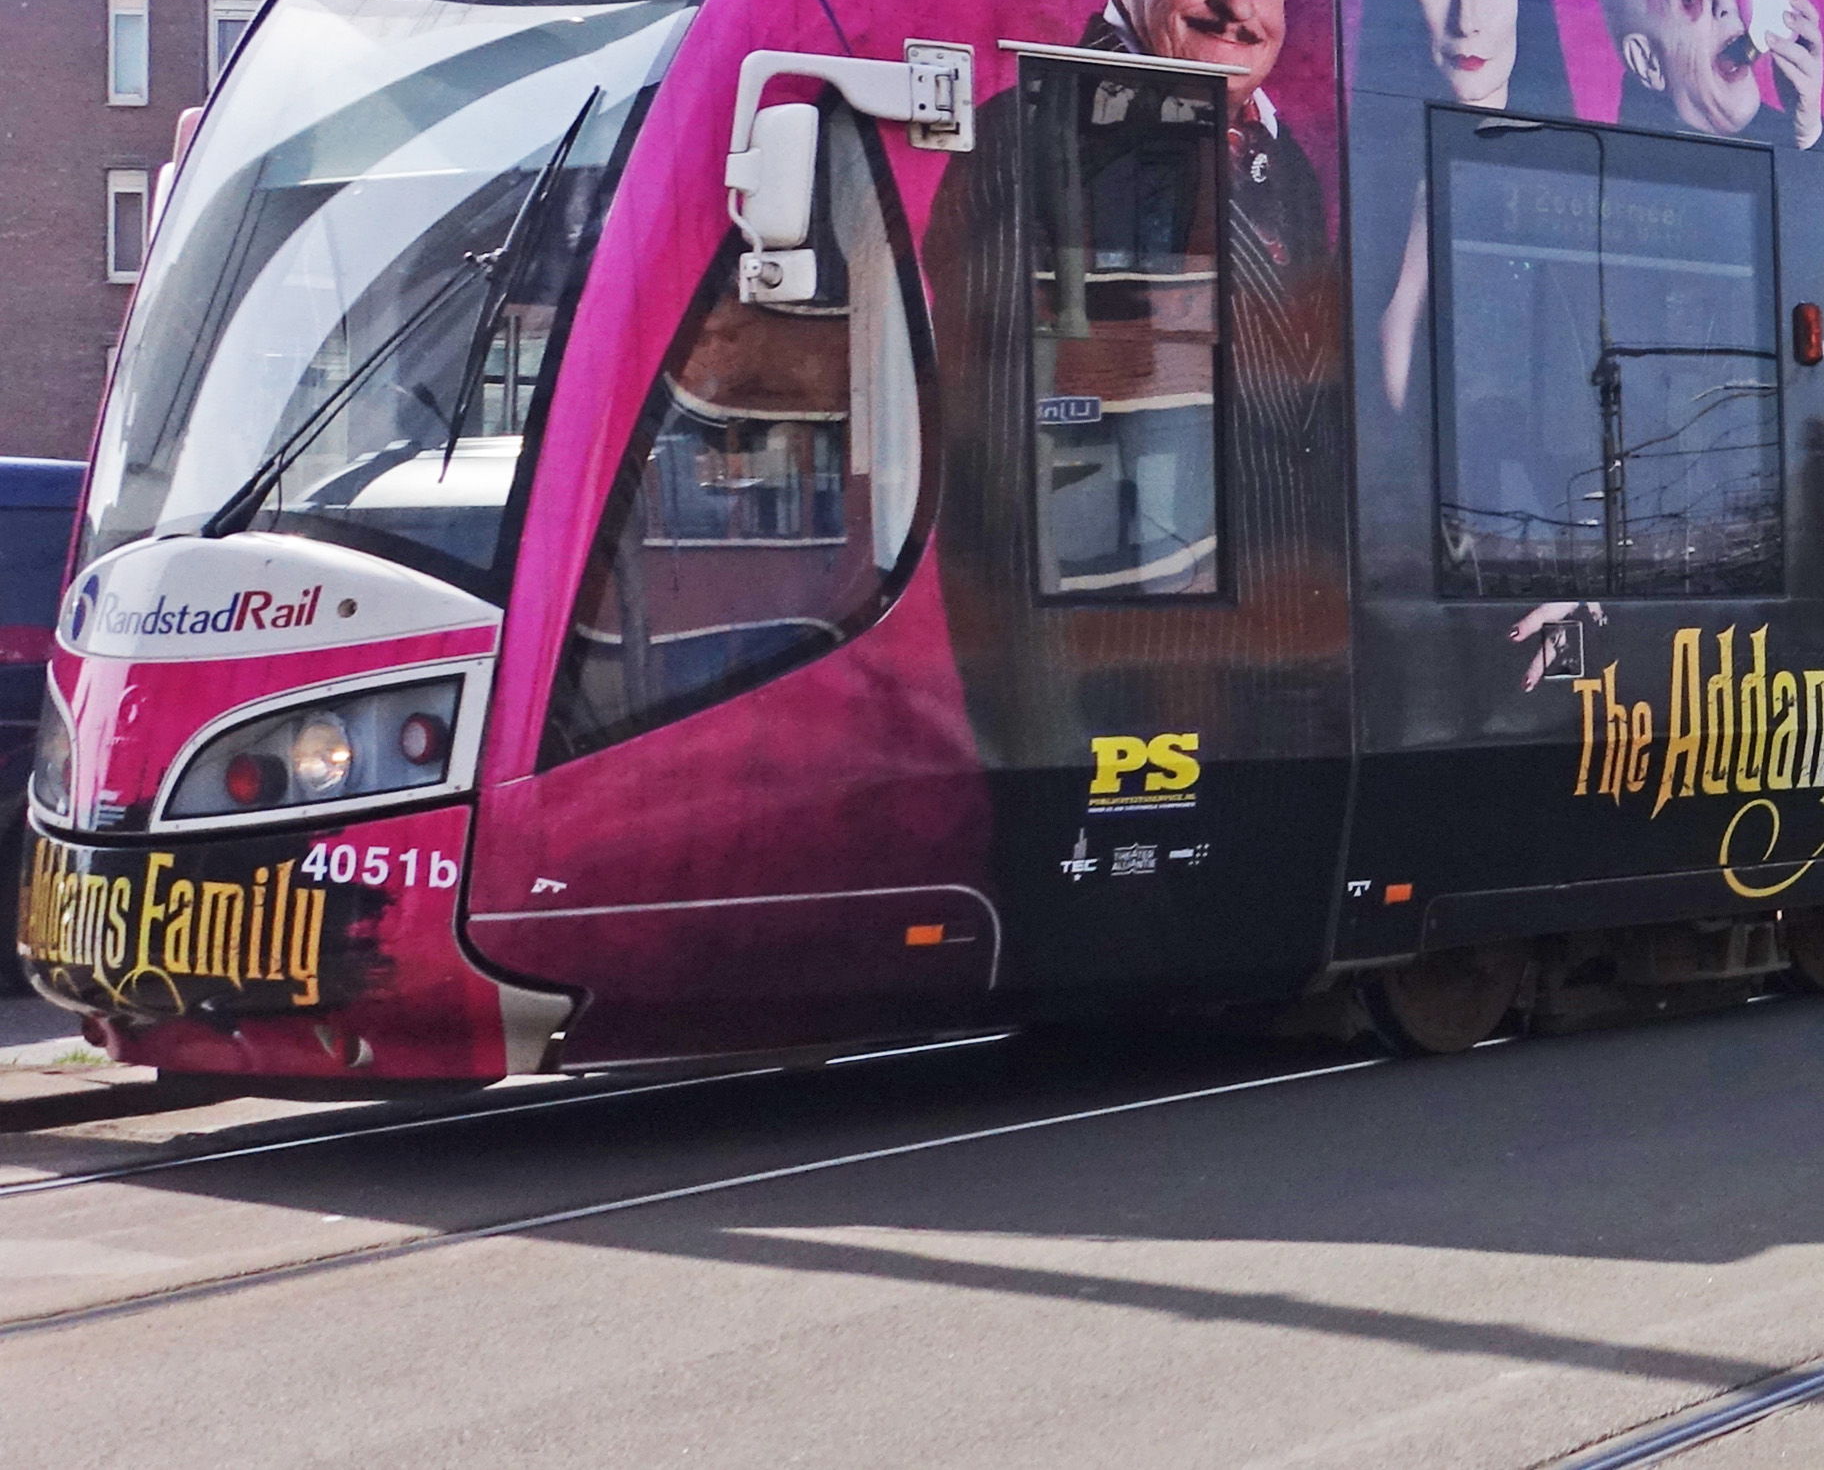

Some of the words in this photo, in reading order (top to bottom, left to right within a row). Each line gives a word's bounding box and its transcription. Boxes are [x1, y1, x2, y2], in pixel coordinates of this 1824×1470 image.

[102, 585, 323, 635] RandstadRail
[1573, 659, 1653, 808] The
[1089, 732, 1201, 794] PS
[301, 842, 458, 889] 4051b
[1060, 859, 1098, 873] TEC
[138, 851, 327, 1007] Family
